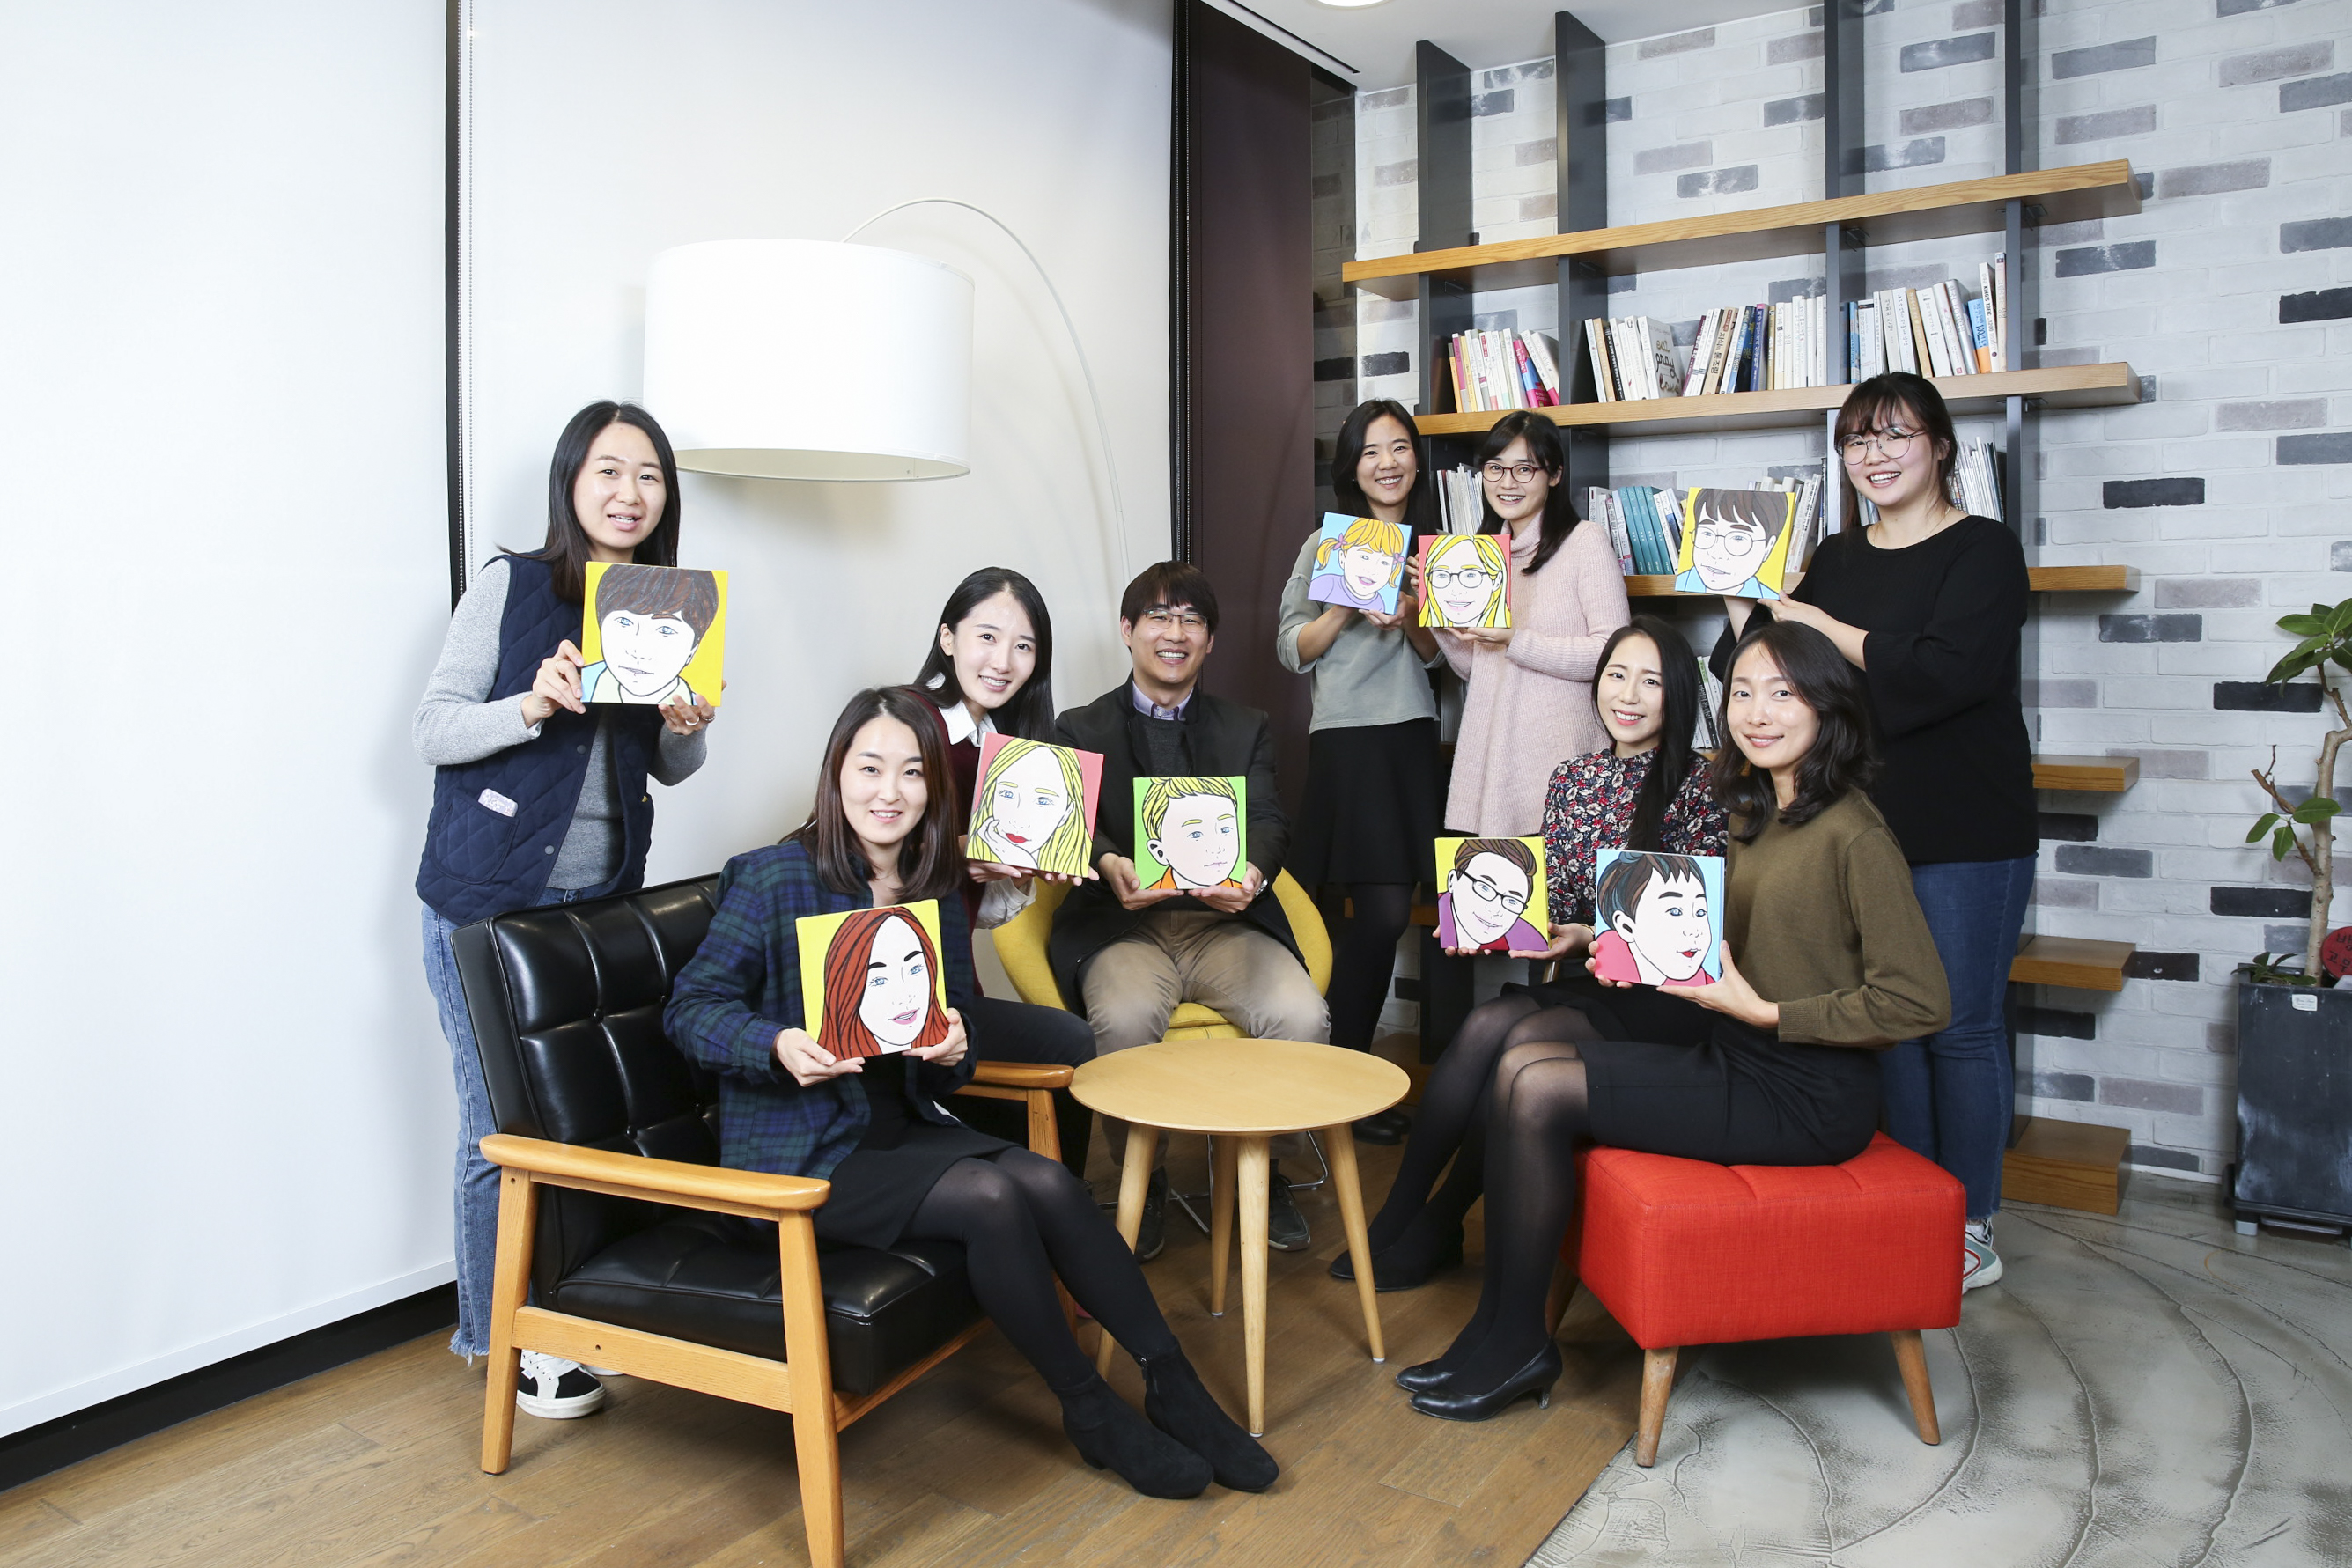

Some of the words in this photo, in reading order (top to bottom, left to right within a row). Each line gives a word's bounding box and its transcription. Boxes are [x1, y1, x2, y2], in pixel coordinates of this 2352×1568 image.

[1656, 340, 1670, 352] eat
[1655, 352, 1679, 384] pray
[1710, 352, 1722, 374] 통조림
[1659, 372, 1679, 394] love
